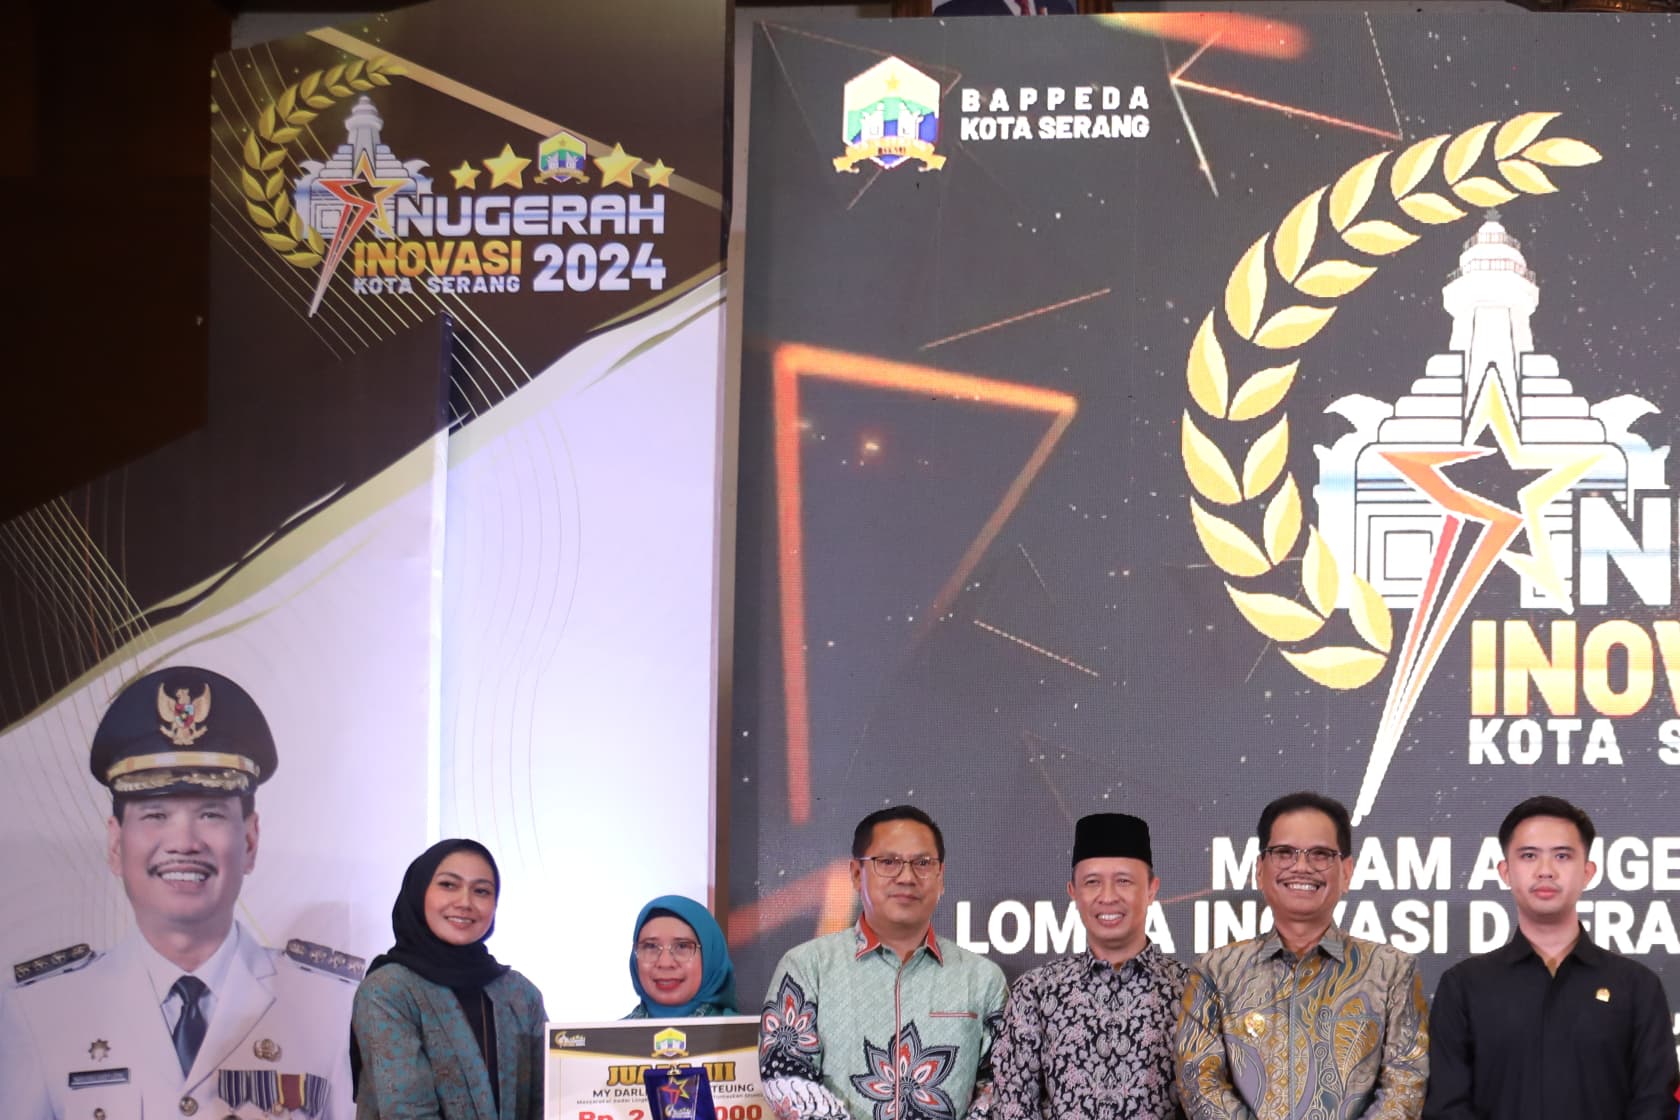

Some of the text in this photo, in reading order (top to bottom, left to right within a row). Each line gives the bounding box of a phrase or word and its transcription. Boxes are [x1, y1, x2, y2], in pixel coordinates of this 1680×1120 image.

[961, 86, 1149, 112] BAPPEDA
[960, 115, 1150, 141] KOTA SERANG
[354, 240, 522, 277] INOVASI
[533, 243, 666, 292] 2024
[354, 276, 521, 295] KOTA SERANG
[1469, 717, 1623, 766] KOTA
[1211, 836, 1451, 890] MAM
[956, 901, 1176, 955] LOMA
[1194, 900, 1448, 955] INASI
[592, 1088, 611, 1098] MY
